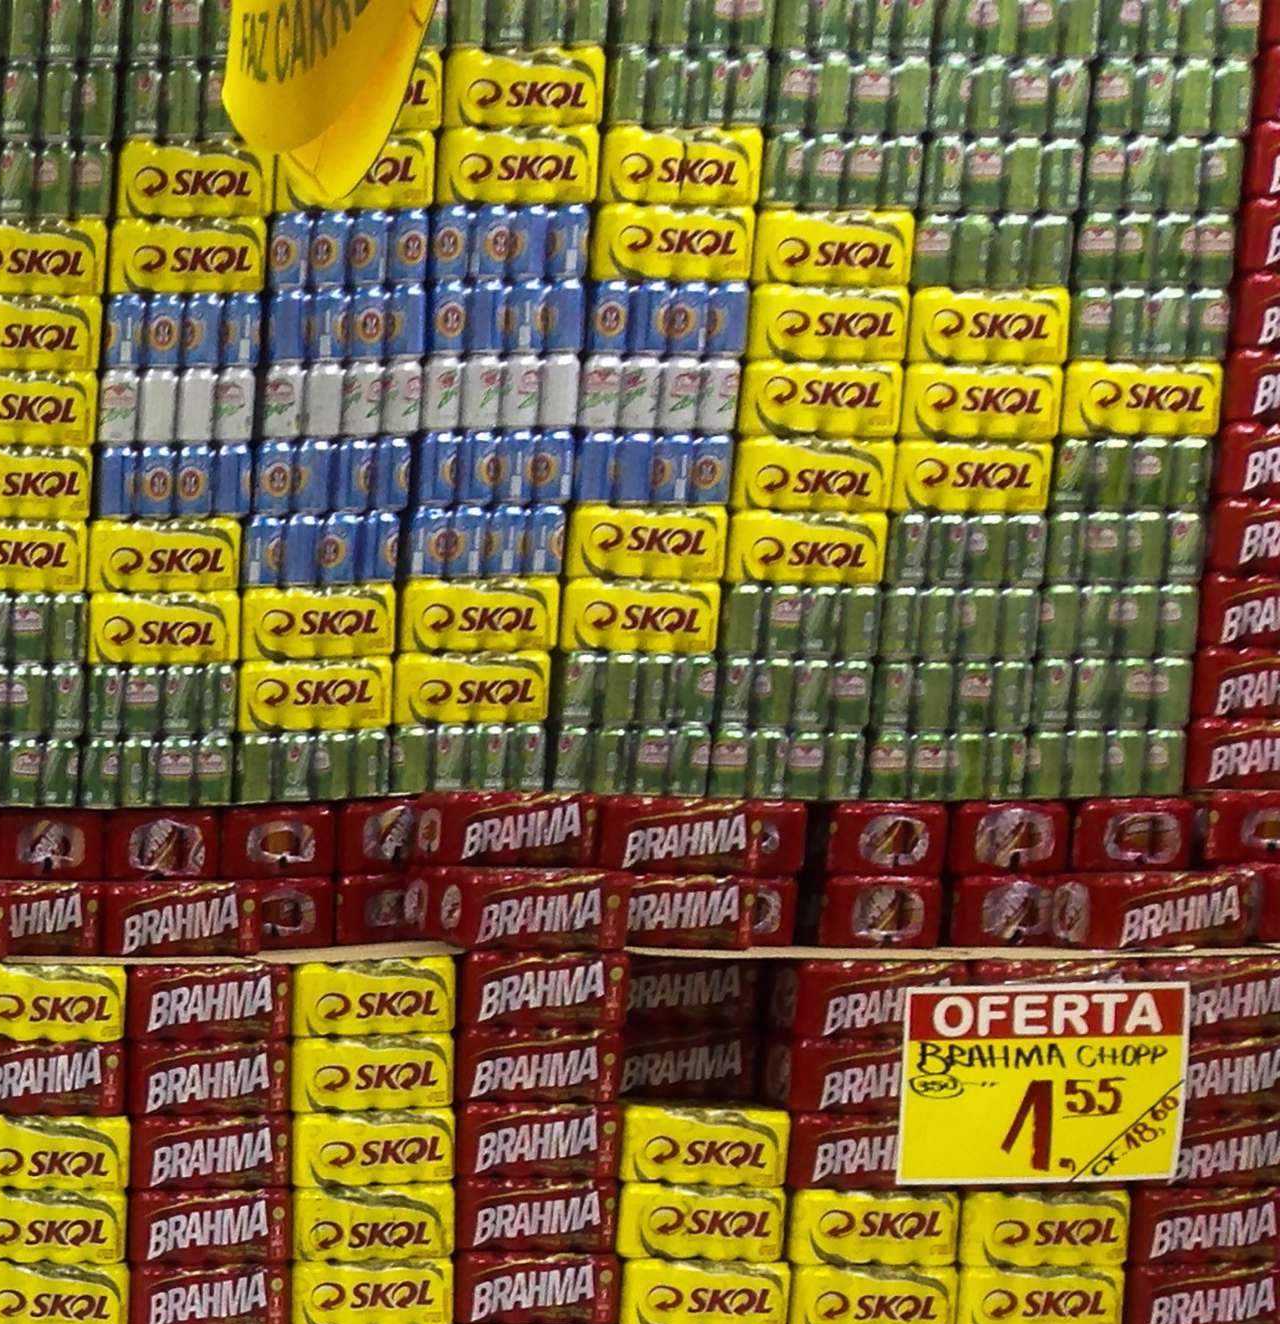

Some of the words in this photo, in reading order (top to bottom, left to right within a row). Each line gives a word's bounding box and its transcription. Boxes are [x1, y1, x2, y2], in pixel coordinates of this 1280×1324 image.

[507, 82, 585, 108] SKOL
[174, 246, 251, 274] SKOL
[815, 242, 892, 268] SKOL
[802, 381, 880, 408] SKOL
[1127, 384, 1204, 412] SKOL
[149, 548, 224, 574] SKOL
[788, 542, 865, 568] SKOL
[457, 679, 534, 705] SKOL
[622, 814, 746, 868] BRAHMA
[122, 893, 238, 954] BRAHMA
[1119, 885, 1240, 947] BRAHMA
[357, 991, 437, 1018] SKOL
[478, 961, 605, 1022] BRAHMA
[30, 996, 110, 1023] SKOL
[932, 992, 1164, 1038] OFERTA
[916, 1041, 1067, 1075] BRAHMA
[1076, 1044, 1168, 1069] CHOPP
[28, 1151, 108, 1177] SKOL
[150, 1127, 273, 1187] BRAHMA
[361, 1137, 443, 1165] SKOL
[473, 1181, 601, 1246] BRAHMA
[687, 1210, 770, 1238] SKOL
[351, 1280, 433, 1308] SKOL
[1023, 1291, 1105, 1317] SKOL
